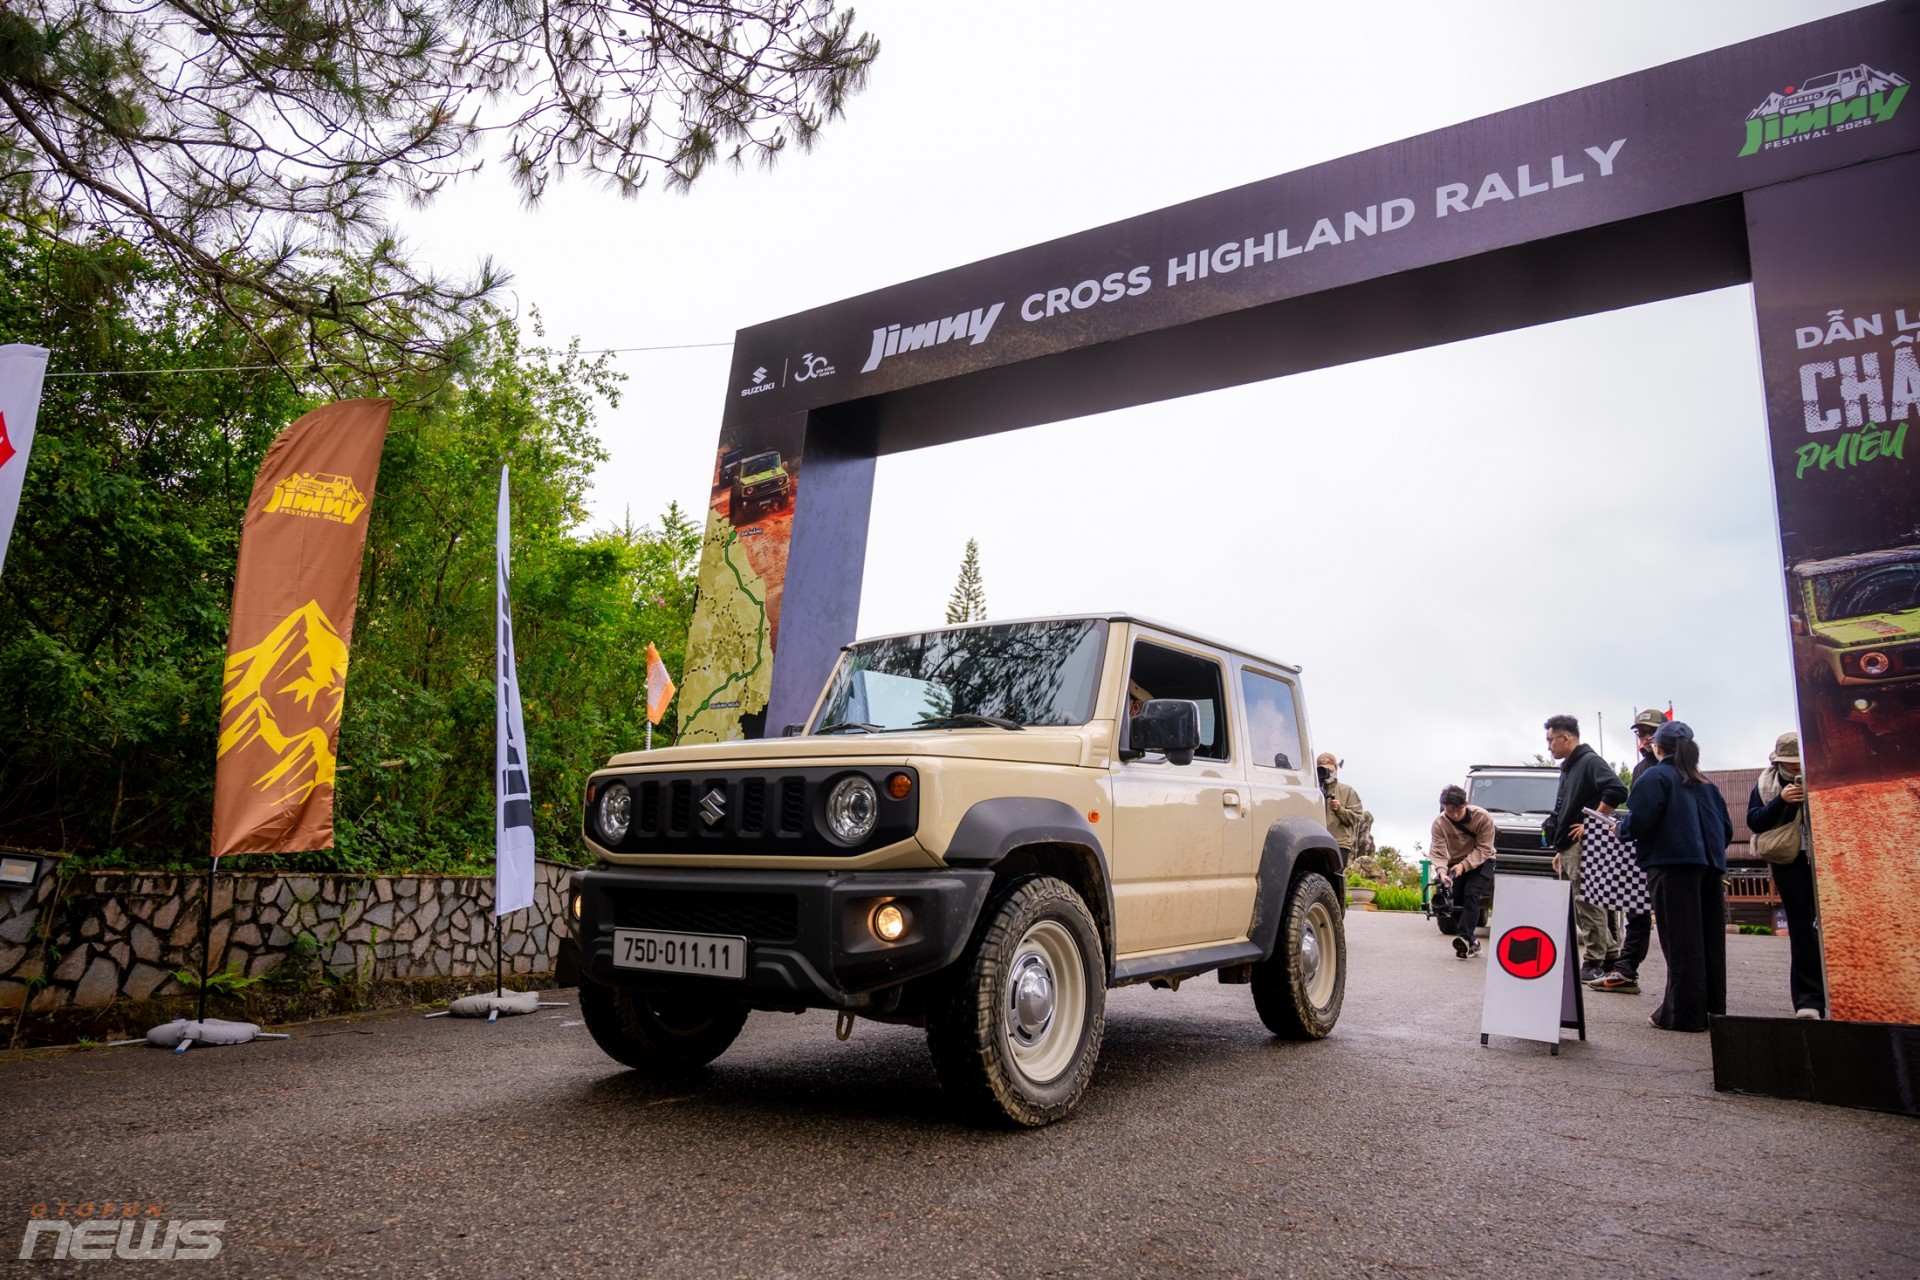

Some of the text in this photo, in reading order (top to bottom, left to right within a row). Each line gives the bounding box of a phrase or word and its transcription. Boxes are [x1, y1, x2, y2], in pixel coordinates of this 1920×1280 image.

[1737, 84, 1911, 157] Jimny
[1764, 117, 1873, 151] FESTIVAL 2026
[860, 138, 1628, 373] Jimny CROSS HIGHLAND RALLY
[1795, 308, 1920, 350] DẪN L
[741, 382, 775, 397] SUZUKI
[1795, 420, 1910, 480] PHIÊU
[262, 486, 367, 525] Jimny
[280, 507, 320, 519] FESTIVAL
[623, 937, 730, 970] 75D-011.11
